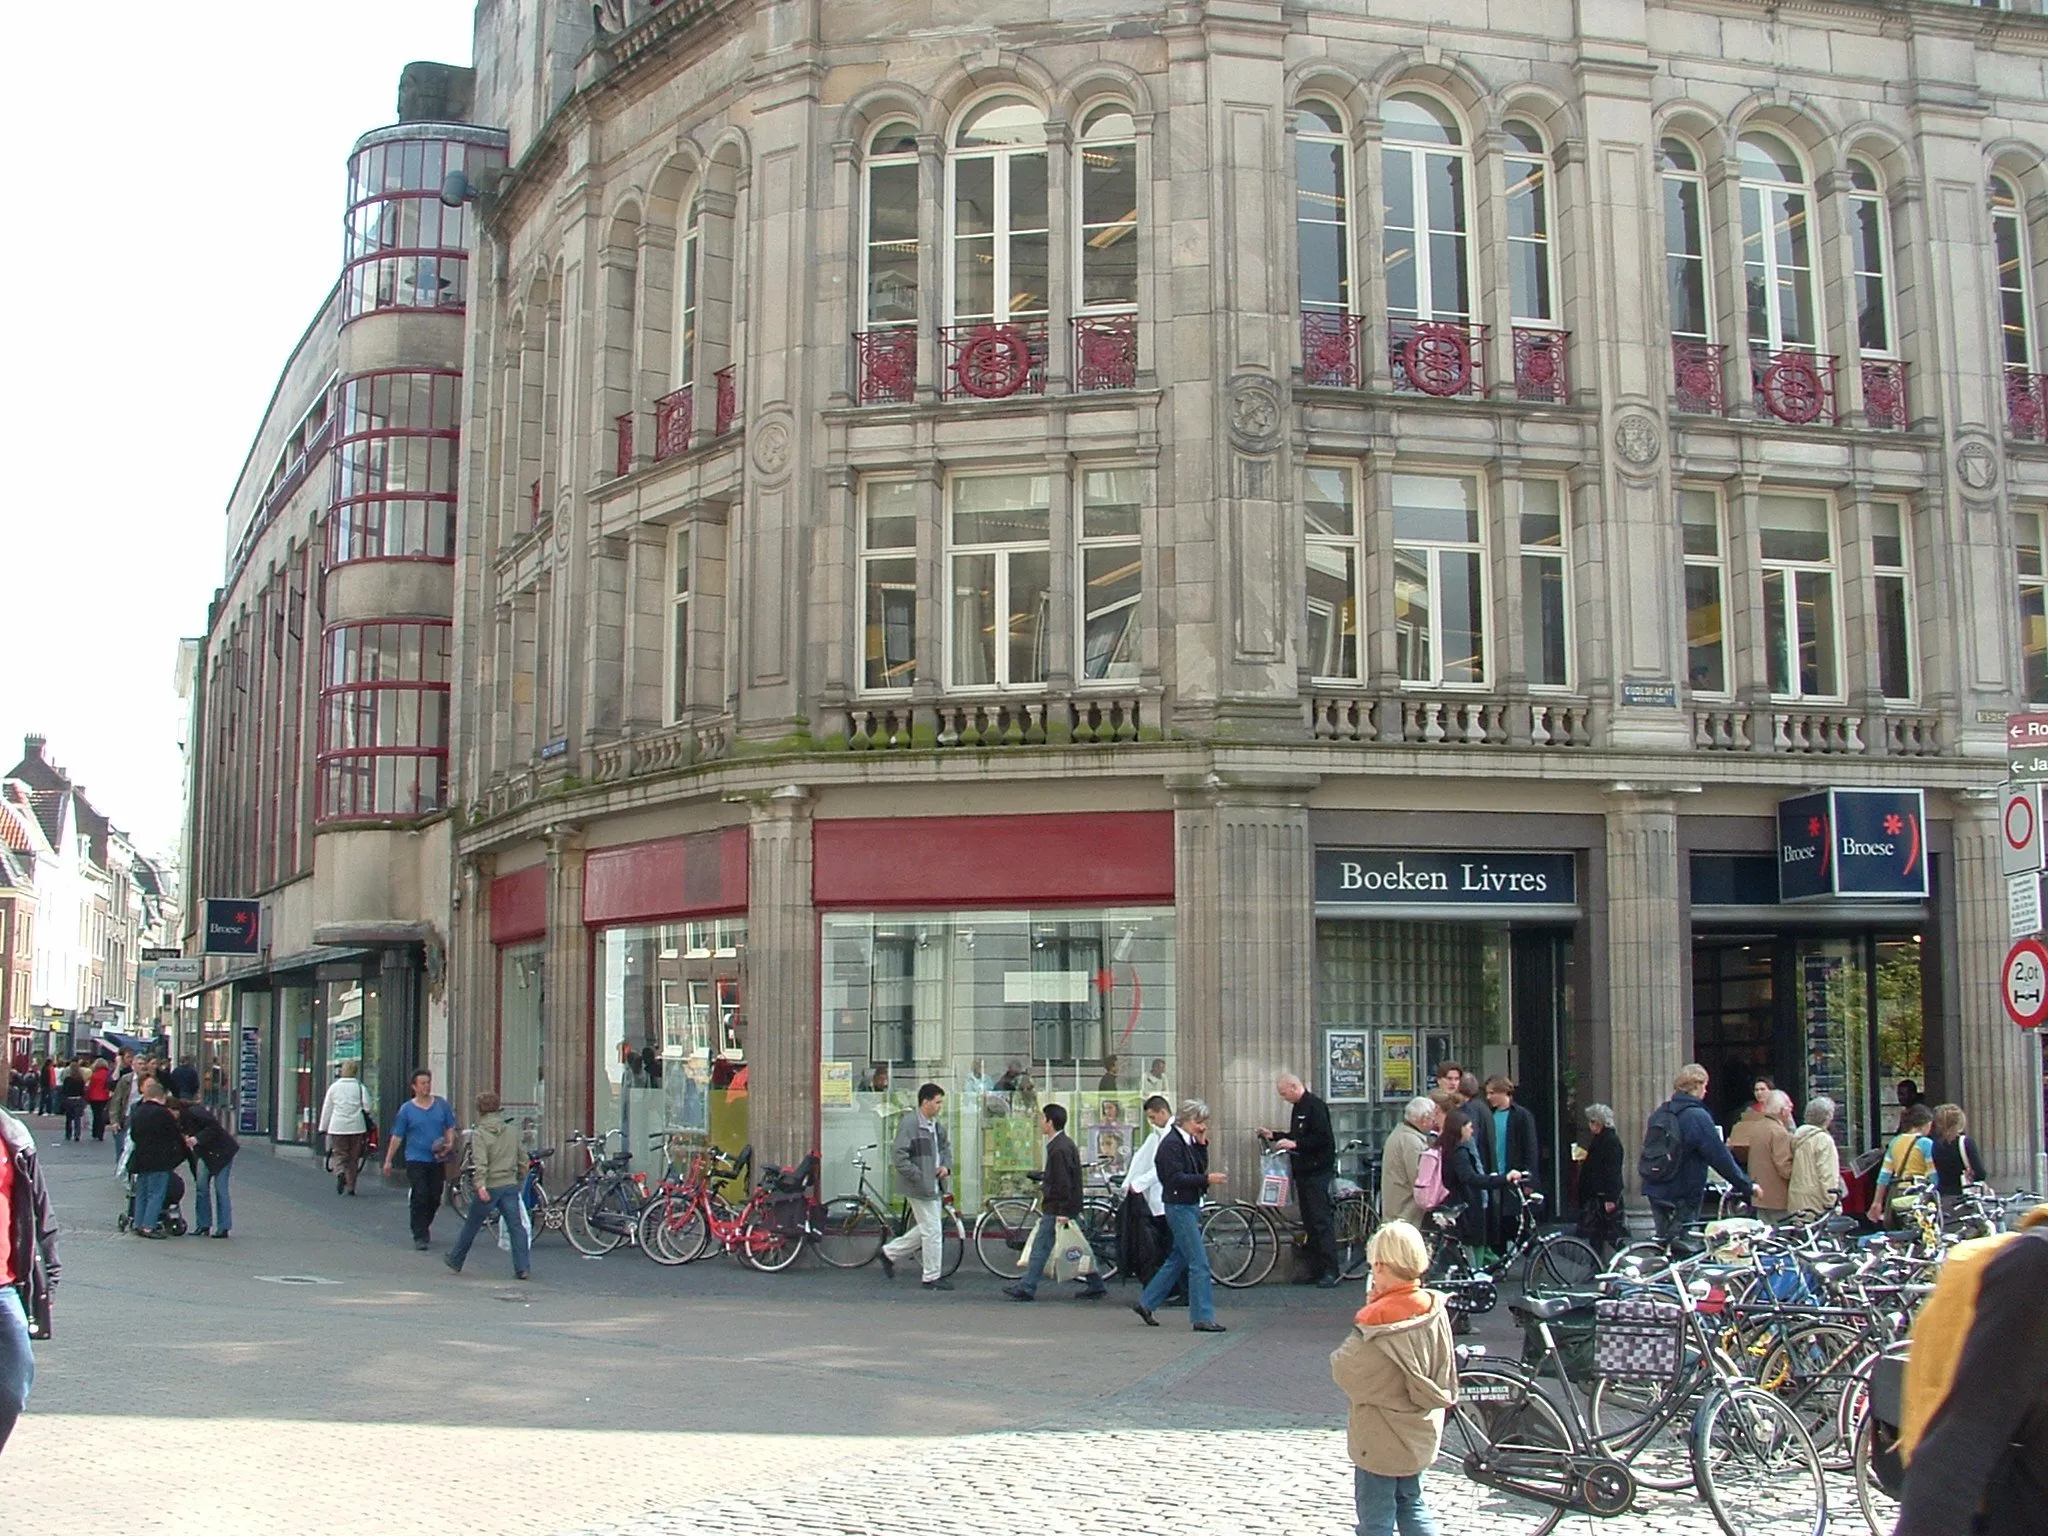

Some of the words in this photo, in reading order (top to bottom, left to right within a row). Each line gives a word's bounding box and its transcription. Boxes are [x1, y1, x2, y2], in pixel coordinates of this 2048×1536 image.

[1784, 845, 1816, 863] Broese
[1842, 837, 1895, 856] Broese
[1340, 861, 1448, 891] Boeken
[1461, 864, 1547, 891] Livres
[210, 922, 243, 934] Broese
